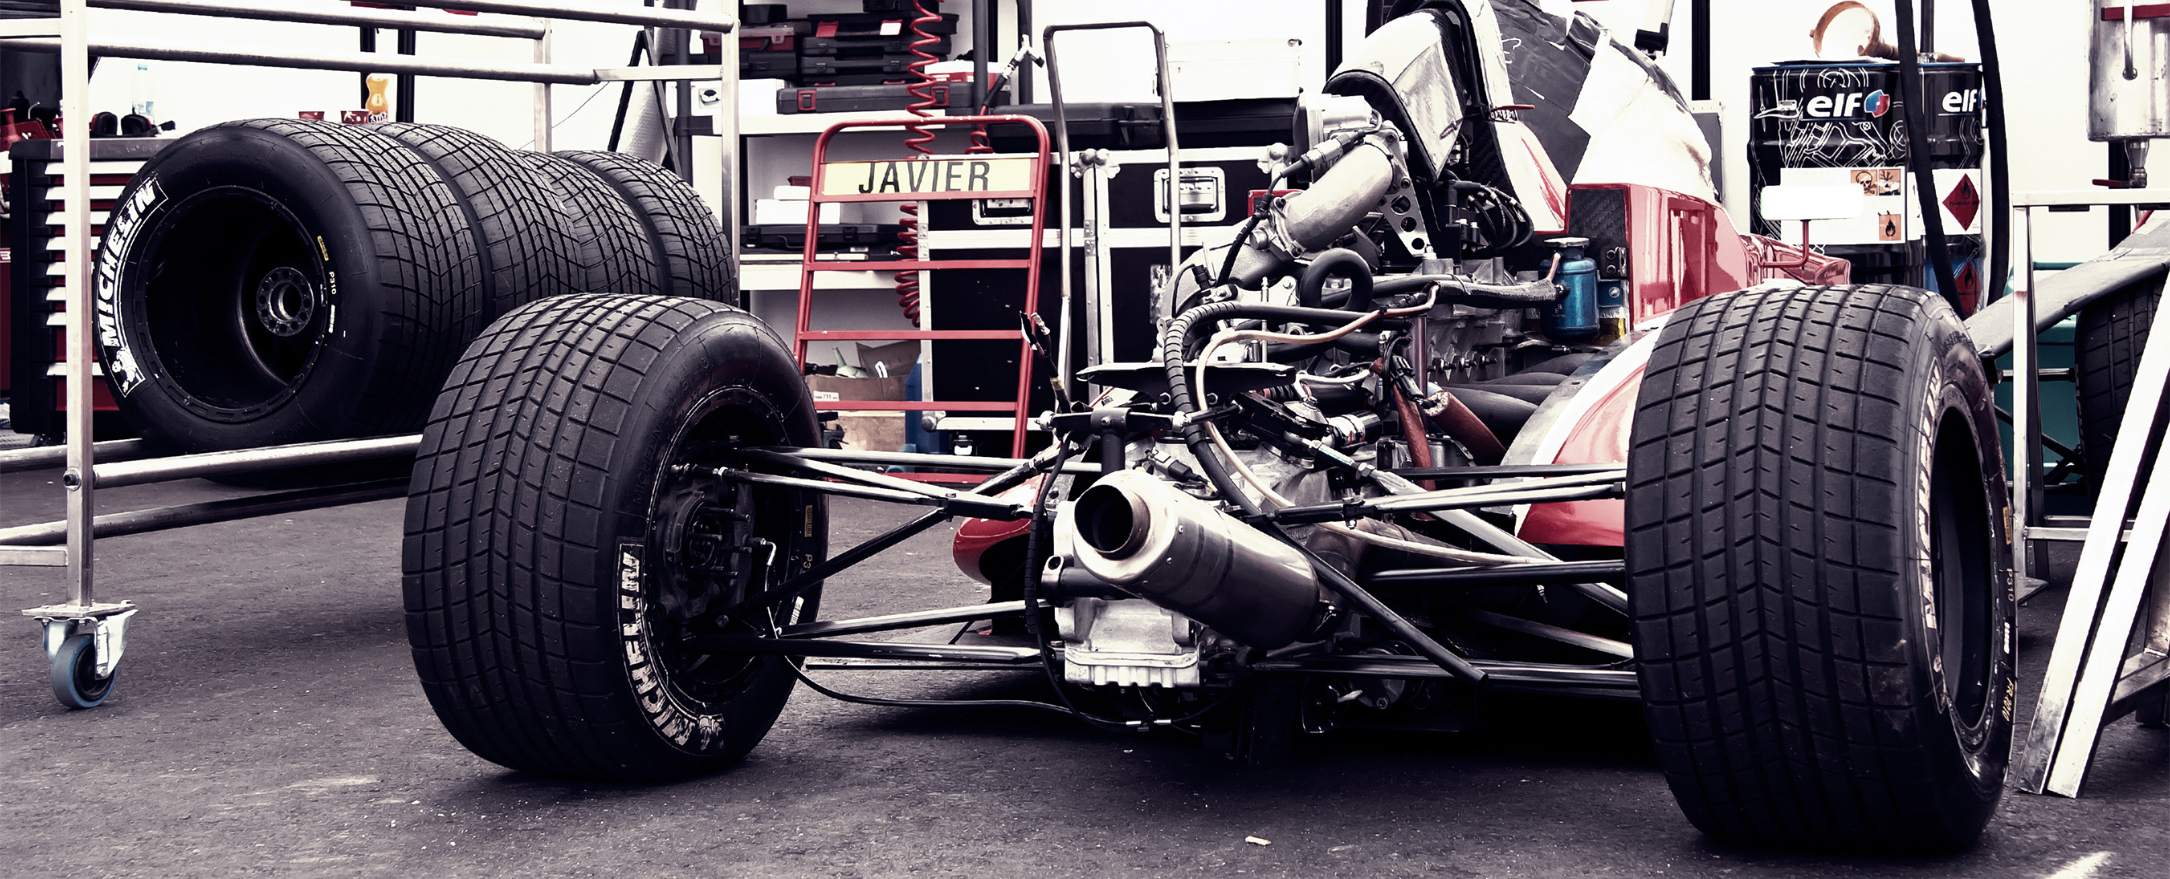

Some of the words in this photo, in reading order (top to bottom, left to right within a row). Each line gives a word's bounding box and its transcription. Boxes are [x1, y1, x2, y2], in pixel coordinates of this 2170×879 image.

[1806, 92, 1863, 118] elf
[1942, 89, 1978, 113] elf
[858, 160, 990, 194] JAVIER
[97, 180, 156, 348] MICHELIN
[328, 271, 337, 295] P310
[2006, 568, 2015, 602] P310
